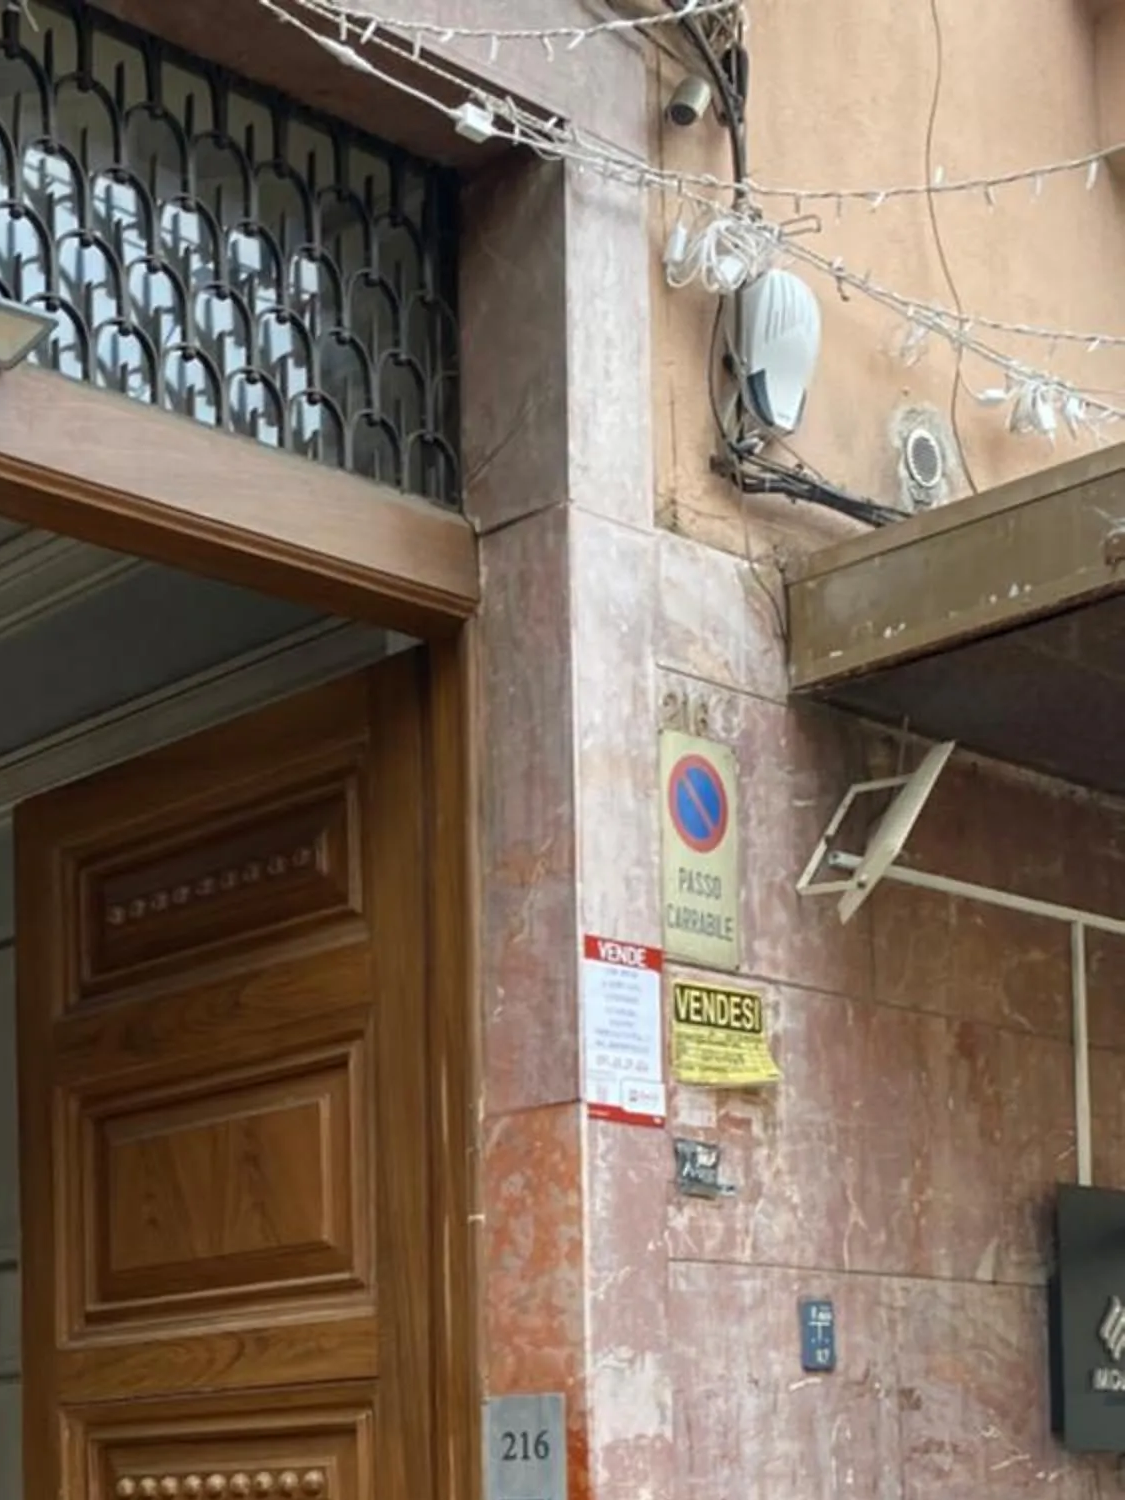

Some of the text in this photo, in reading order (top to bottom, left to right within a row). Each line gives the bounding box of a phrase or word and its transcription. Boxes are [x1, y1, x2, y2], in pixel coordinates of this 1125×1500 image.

[679, 867, 722, 899] PASSO
[666, 903, 734, 942] CARRABILE
[596, 939, 646, 969] VENDE
[675, 986, 761, 1031] VENDESI
[501, 1429, 550, 1461] 216
